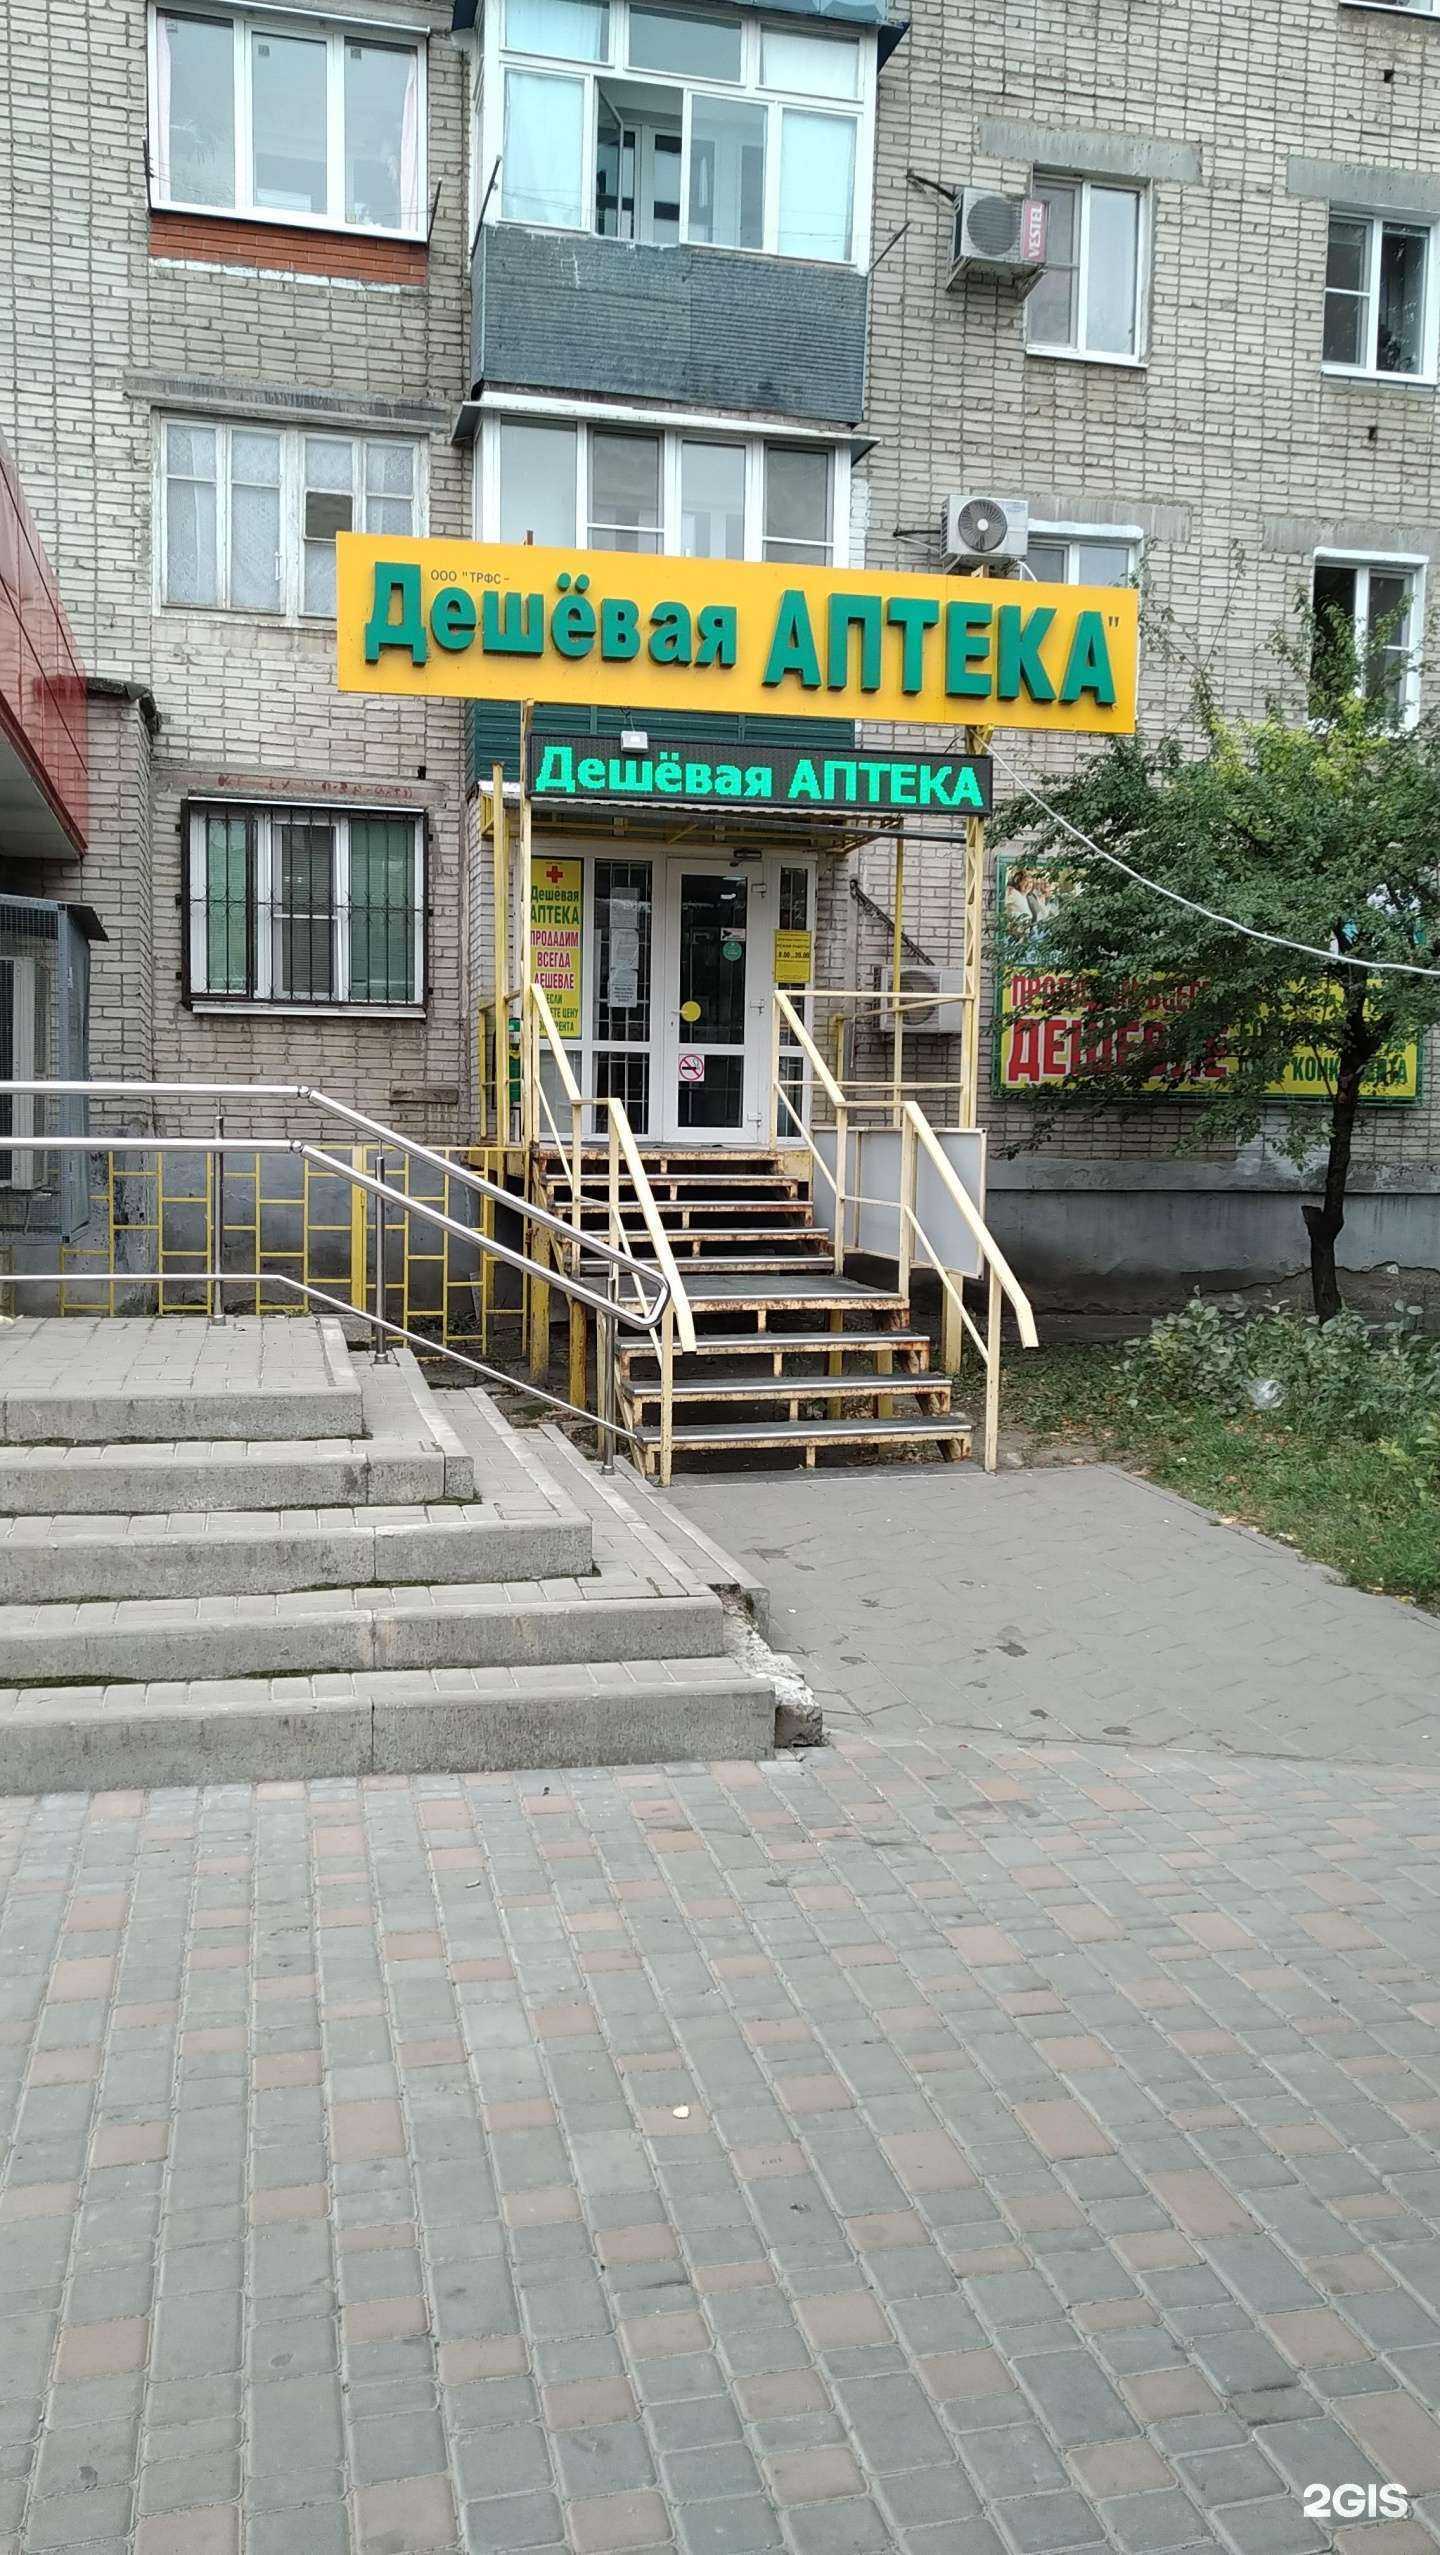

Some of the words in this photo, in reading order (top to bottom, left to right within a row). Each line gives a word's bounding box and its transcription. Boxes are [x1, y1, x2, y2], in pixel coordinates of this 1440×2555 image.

[1029, 203, 1042, 257] VESTEL
[430, 569, 457, 582] ООО
[365, 561, 737, 668] Дешёвая
[536, 746, 772, 797] Дешёвая
[788, 760, 984, 806] АПТЕКА
[531, 904, 579, 924] АПТЕКА
[531, 930, 578, 947] ПРОДАДИМ
[537, 951, 571, 968] ВСЕГДА
